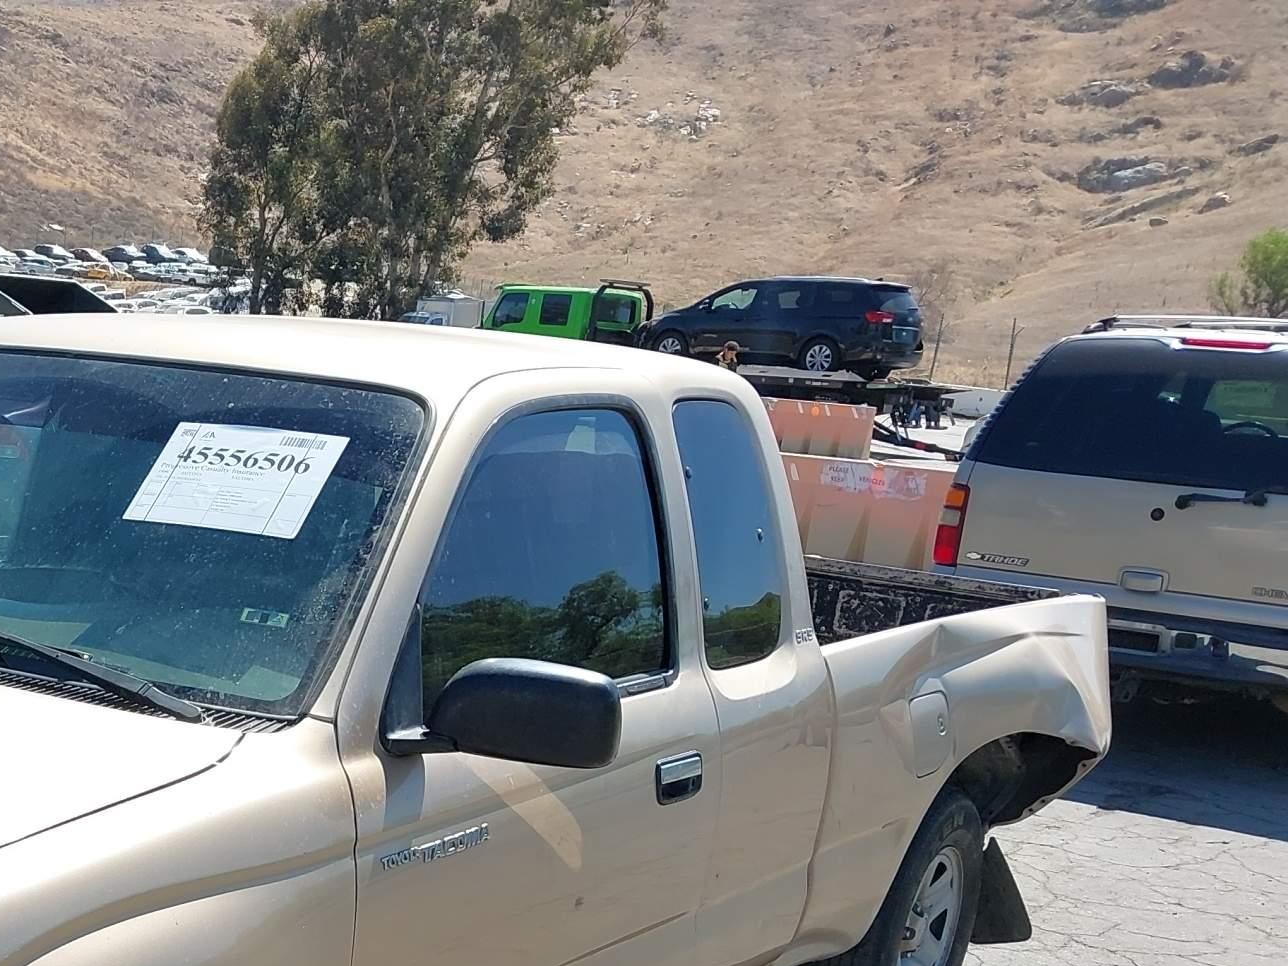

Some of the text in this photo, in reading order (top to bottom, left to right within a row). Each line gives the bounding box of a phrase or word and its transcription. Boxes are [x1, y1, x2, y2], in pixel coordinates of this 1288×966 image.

[177, 445, 317, 474] 45556506
[983, 554, 1029, 567] TAHOE
[420, 822, 491, 864] TACOMA
